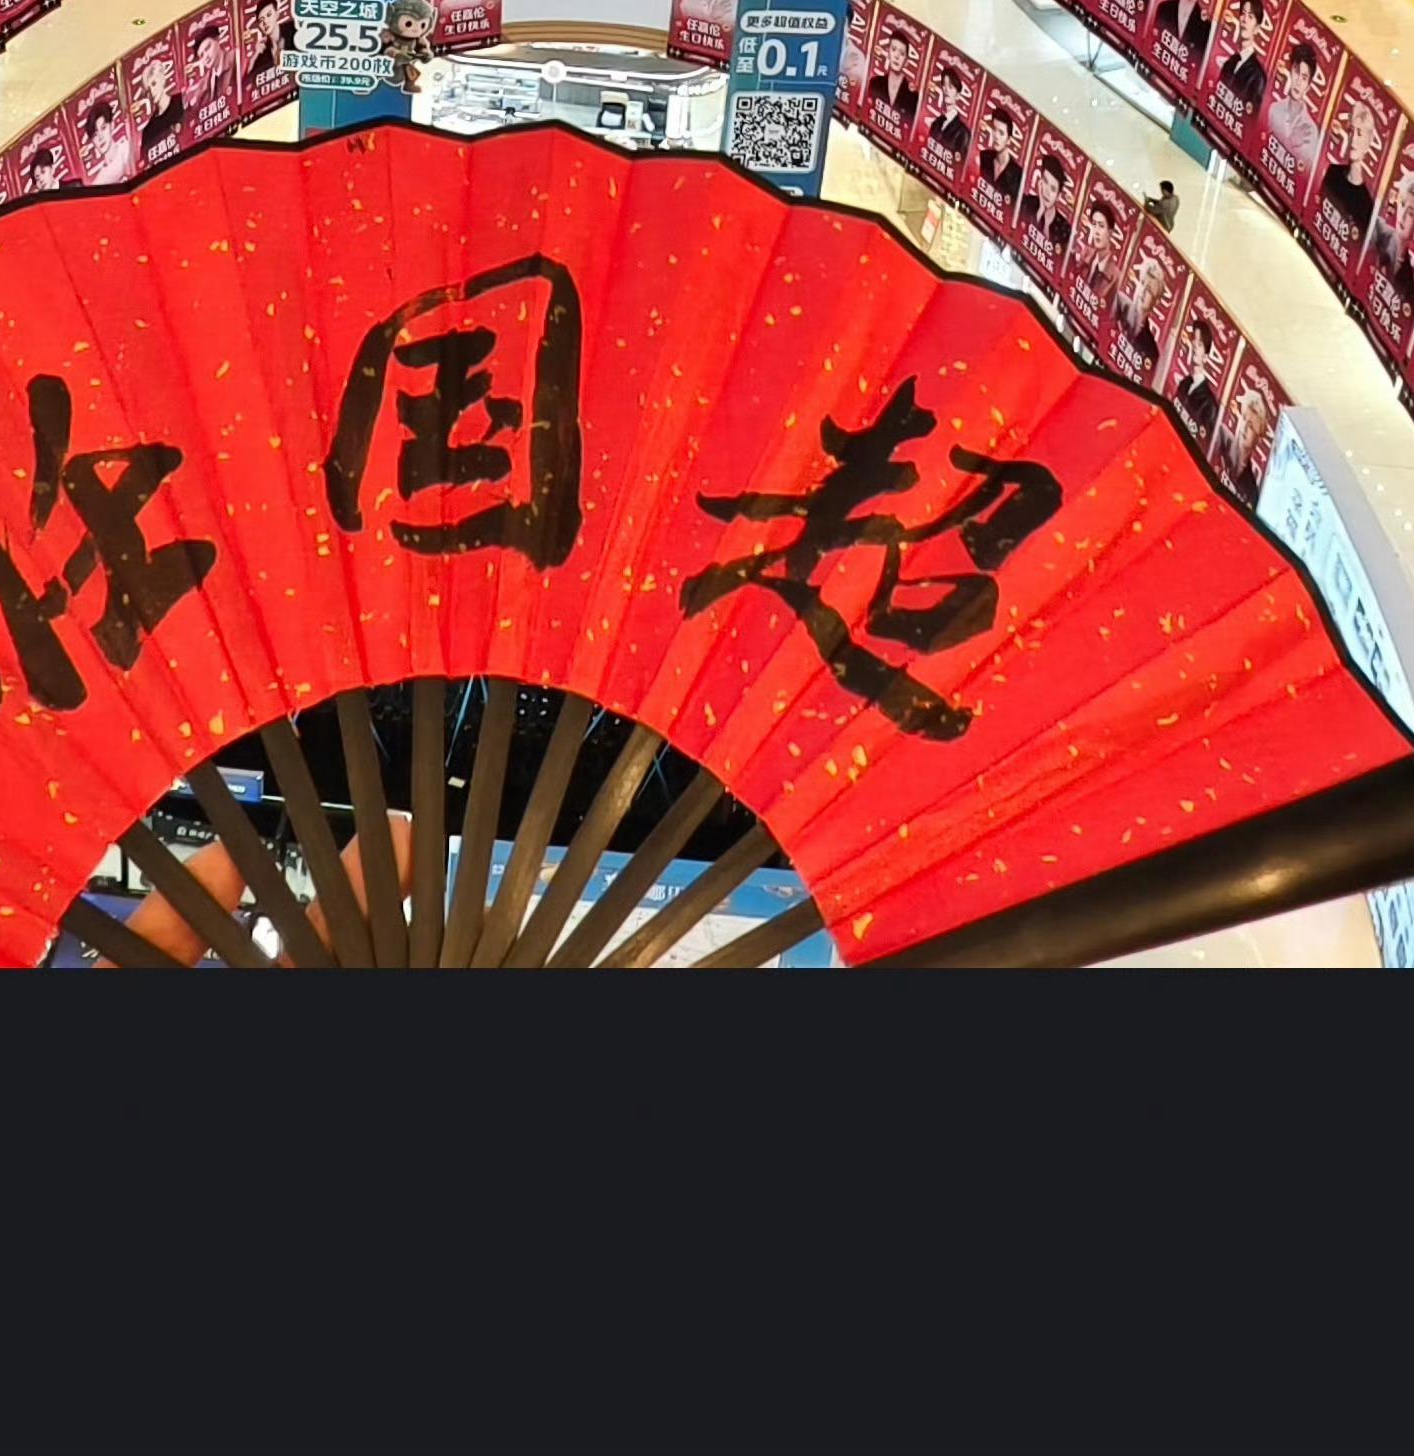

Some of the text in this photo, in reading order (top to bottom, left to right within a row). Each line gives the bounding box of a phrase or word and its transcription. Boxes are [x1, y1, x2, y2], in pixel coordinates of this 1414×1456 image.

[299, 0, 379, 19] 天空之城
[450, 7, 485, 22] 任嘉伦
[444, 18, 491, 36] 生日快乐
[282, 54, 393, 75] 游戏币200枚
